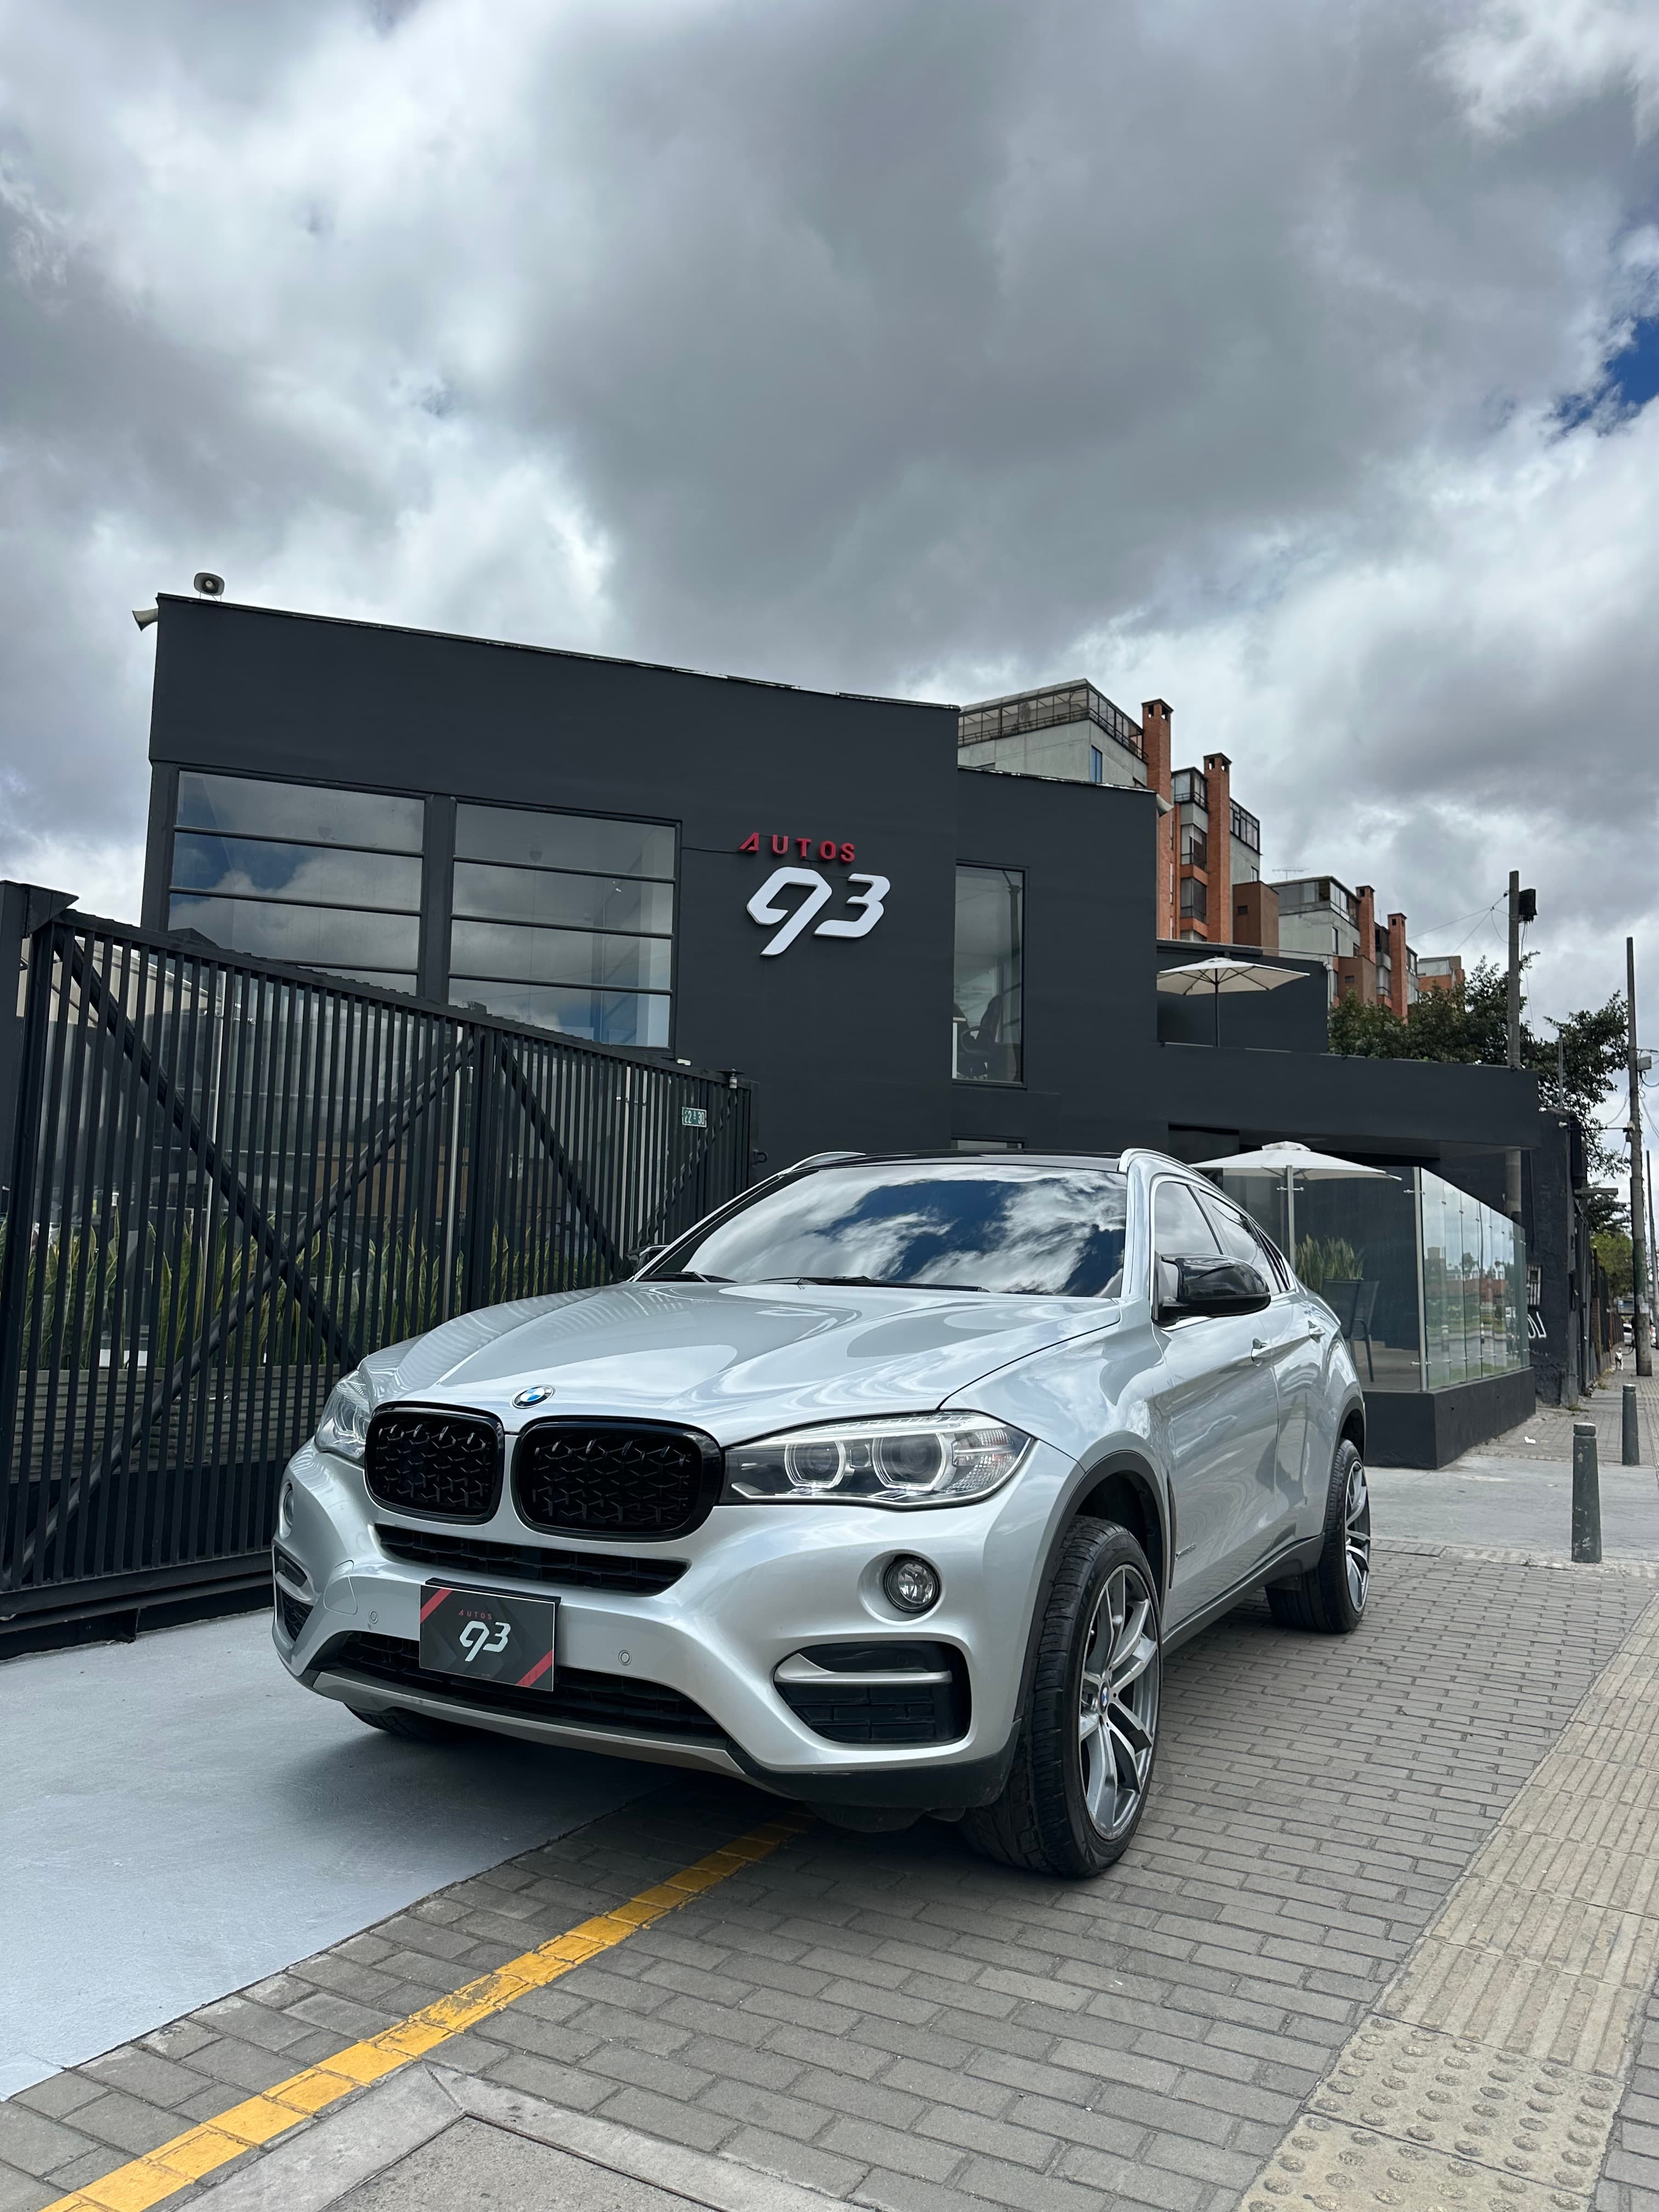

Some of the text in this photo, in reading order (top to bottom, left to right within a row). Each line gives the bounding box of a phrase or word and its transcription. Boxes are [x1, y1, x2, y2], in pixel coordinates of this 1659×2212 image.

[739, 832, 855, 864] AUTOS
[747, 866, 891, 957] 93
[459, 1609, 492, 1620] AUTOS
[459, 1620, 511, 1662] 93
